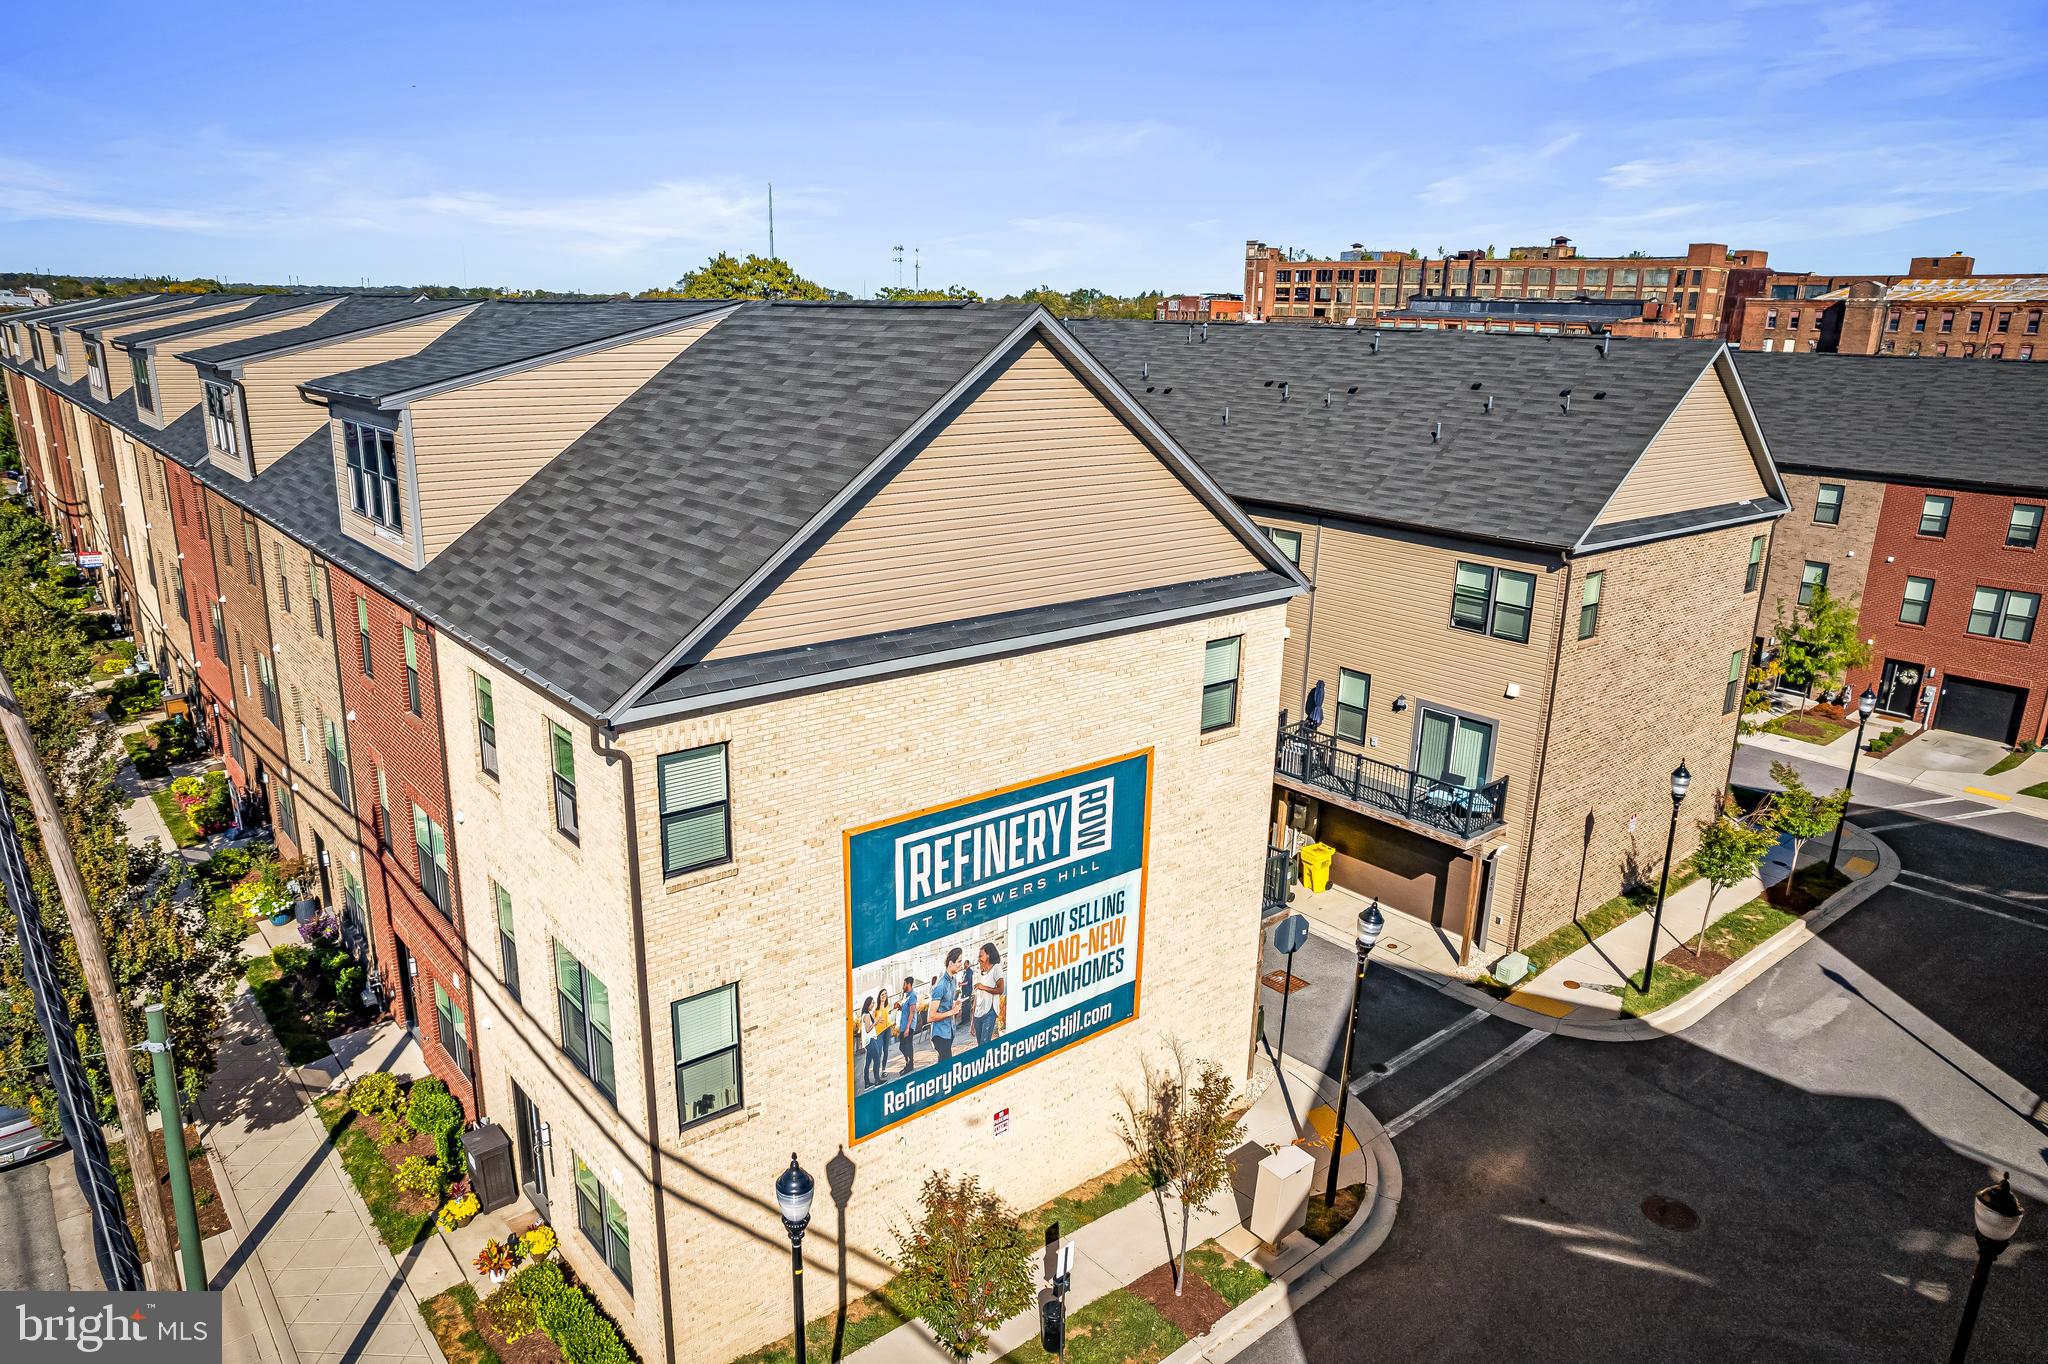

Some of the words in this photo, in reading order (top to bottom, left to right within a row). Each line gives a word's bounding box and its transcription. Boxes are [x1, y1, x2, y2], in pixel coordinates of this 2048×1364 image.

[1077, 785, 1107, 851] ROW
[910, 802, 1067, 902] REFINERY
[908, 916, 933, 934] AT
[946, 878, 1047, 921] BREWERS
[1058, 861, 1100, 883] HILL
[1029, 911, 1065, 947] NOW
[1069, 890, 1125, 932] SELLING
[1022, 916, 1126, 982] BRAND-NEW
[1022, 947, 1125, 1012] TOWNHOMES
[883, 1002, 1112, 1116] RefineryRowAtBrewersHill.com
